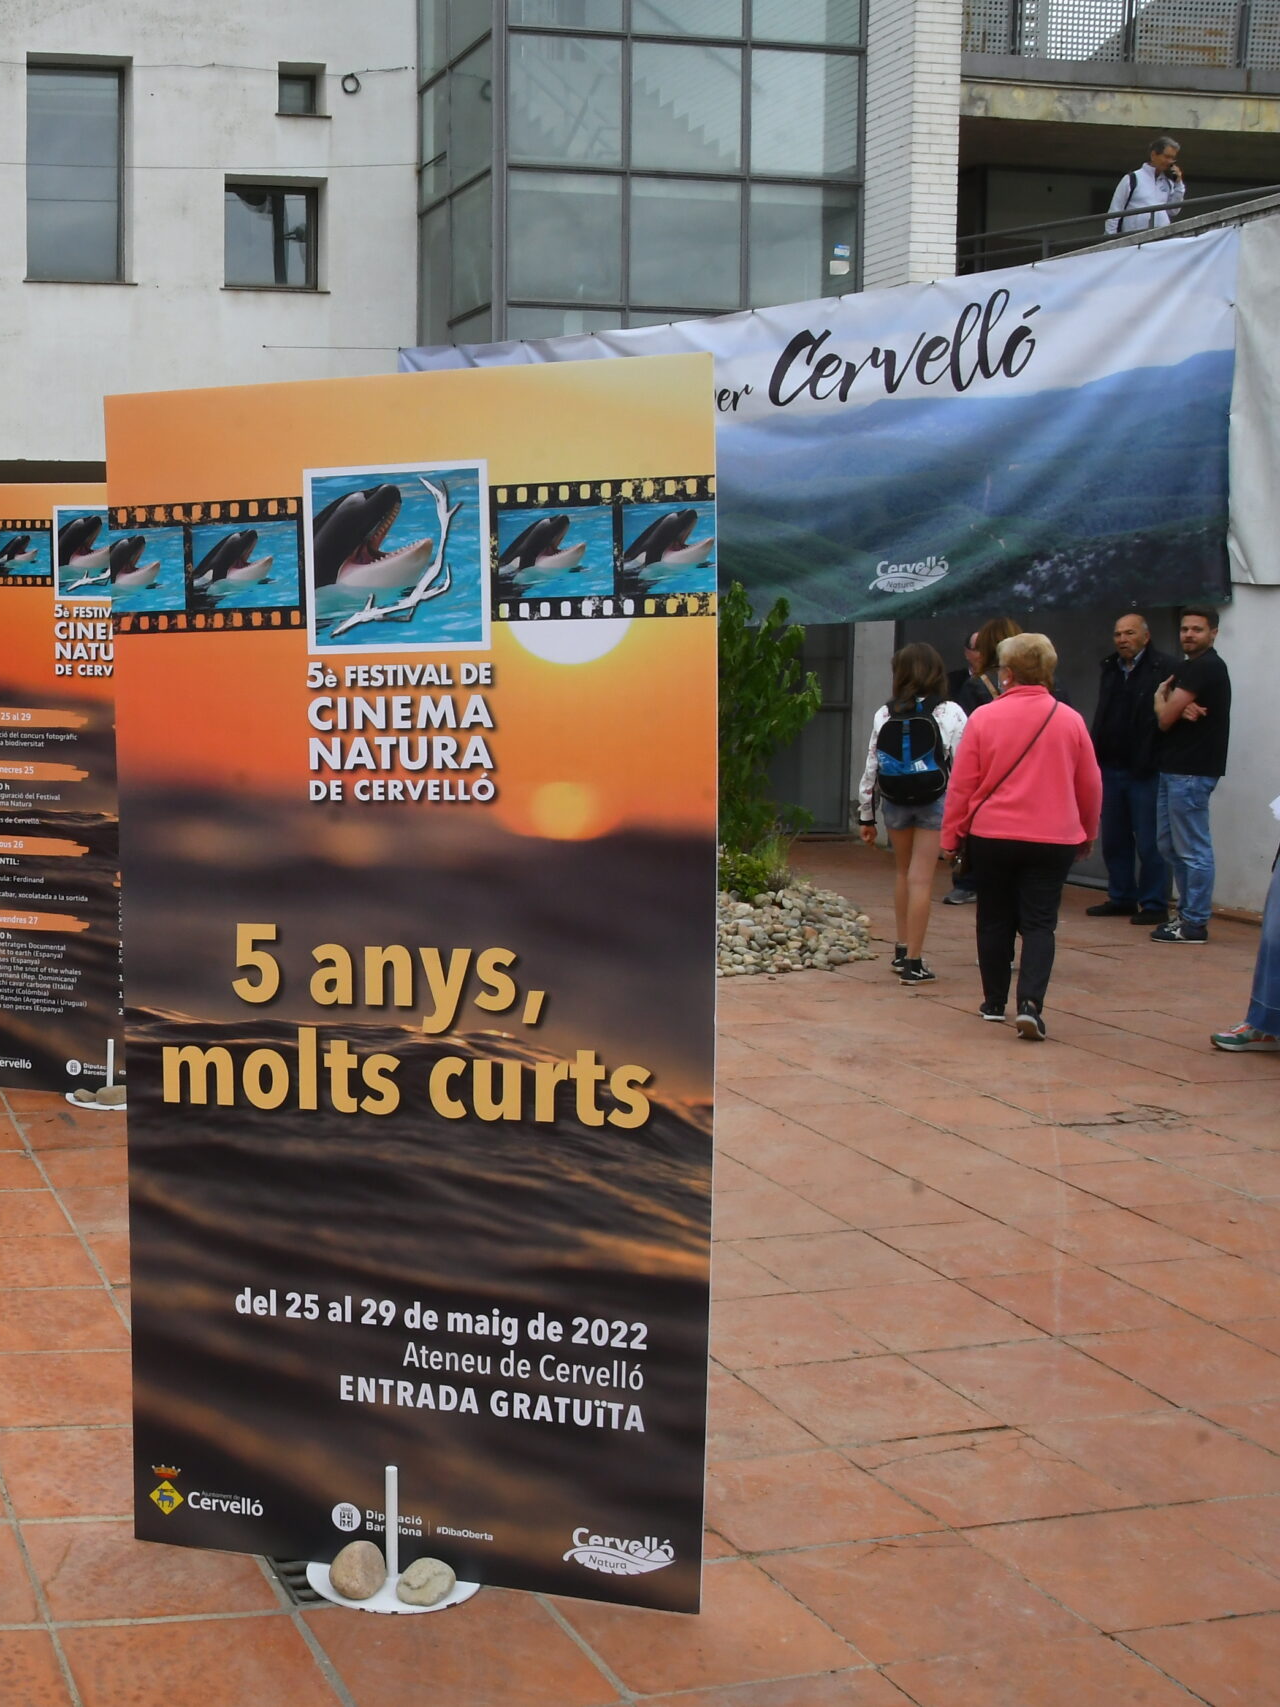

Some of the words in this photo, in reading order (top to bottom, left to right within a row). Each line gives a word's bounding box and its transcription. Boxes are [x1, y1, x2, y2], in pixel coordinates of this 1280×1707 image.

[714, 384, 753, 412] er
[768, 288, 1042, 407] Cervelló
[876, 556, 949, 577] Cervelló
[886, 580, 915, 588] Natura
[54, 604, 70, 618] 5è
[73, 606, 112, 618] FESTIV
[54, 622, 113, 640] CINE
[54, 642, 114, 660] NATU
[55, 664, 72, 676] DE
[78, 664, 113, 676] CERV
[306, 662, 337, 689] 5è
[345, 663, 453, 688] FESTIVAL
[460, 662, 492, 685] DE
[0, 712, 10, 720] 25
[12, 712, 19, 720] al
[21, 712, 32, 721] 29
[307, 694, 494, 731] CINEMA
[5, 739, 44, 747] biodiversitat
[308, 735, 494, 770] NATURA
[24, 766, 34, 774] 25
[309, 780, 342, 801] DE
[354, 772, 495, 801] CERVELLÓ
[14, 840, 24, 849] 26
[13, 876, 44, 884] Ferdinand
[18, 892, 52, 900] xocolatada
[28, 916, 38, 924] 27
[6, 932, 12, 940] h
[29, 942, 66, 951] Documental
[10, 957, 40, 965] (Espanya)
[33, 950, 63, 959] (Espanya)
[38, 974, 77, 983] Dominicana)
[232, 923, 280, 1003] 5
[310, 943, 545, 1033] anys,
[23, 996, 55, 1005] (Argentina
[34, 1005, 63, 1014] (Espanya)
[83, 1062, 107, 1070] Diputac
[162, 1027, 400, 1115] molts
[429, 1050, 651, 1128] curts
[235, 1287, 276, 1316] del
[285, 1292, 320, 1320] 25
[328, 1296, 352, 1323] al
[360, 1298, 396, 1326] 29
[404, 1301, 439, 1331] de
[447, 1308, 518, 1346] maig
[527, 1312, 563, 1342] de
[572, 1317, 648, 1350] 2022
[403, 1342, 491, 1375] Ateneu
[500, 1350, 531, 1378] de
[539, 1354, 644, 1390] Cervelló
[340, 1375, 479, 1414] ENTRADA
[188, 1491, 263, 1516] Cervelló
[366, 1510, 422, 1526] Dipació
[366, 1522, 422, 1537] Barlona
[436, 1526, 494, 1541] #DibaOberta
[572, 1527, 674, 1560] Cervelló
[589, 1555, 627, 1569] Natura
